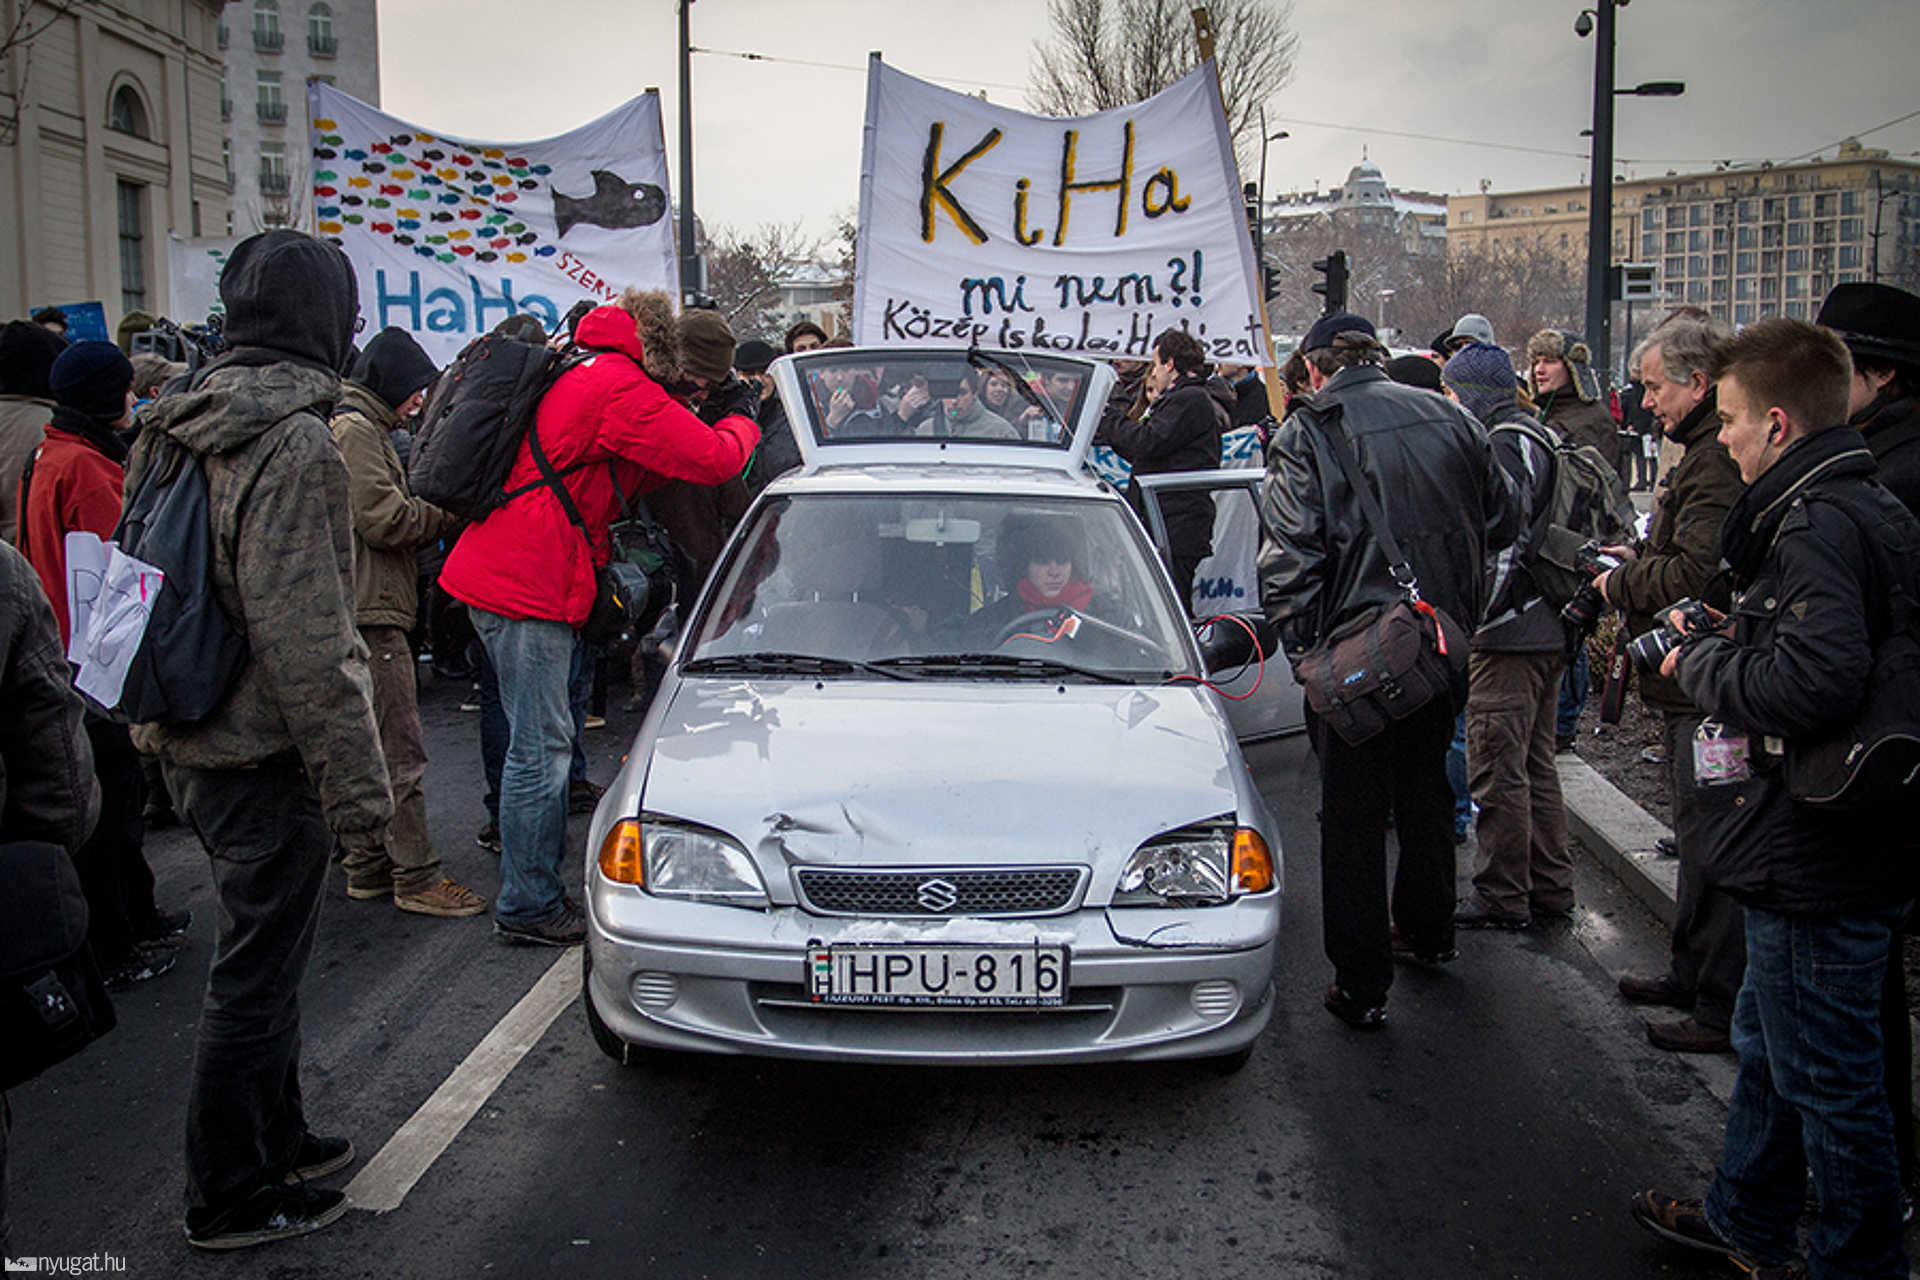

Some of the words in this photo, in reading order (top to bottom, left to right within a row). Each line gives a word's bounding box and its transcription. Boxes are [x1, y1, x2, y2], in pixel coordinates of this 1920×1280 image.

[919, 118, 1191, 246] KiHa
[375, 267, 560, 333] HaHa
[959, 273, 1034, 315] mi
[1054, 249, 1204, 308] nem?!
[815, 974, 832, 993] H
[849, 953, 1060, 994] HPU-816
